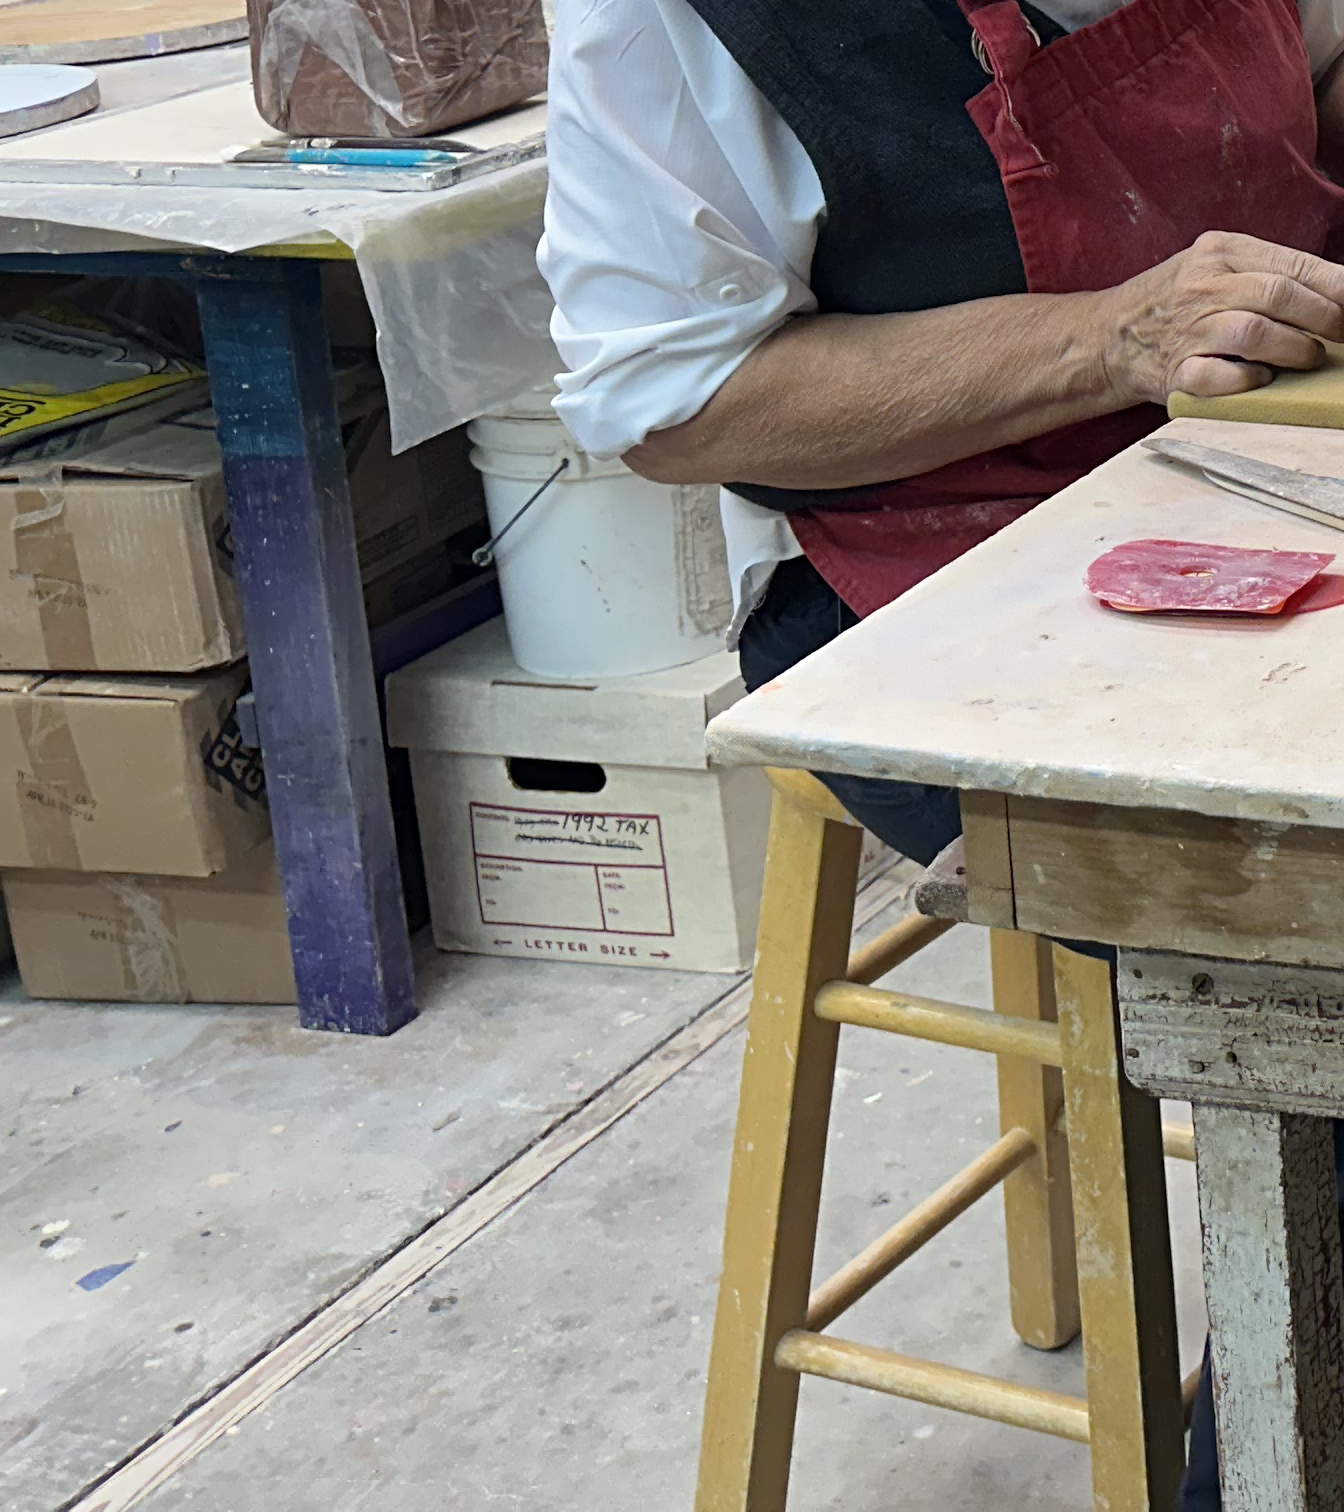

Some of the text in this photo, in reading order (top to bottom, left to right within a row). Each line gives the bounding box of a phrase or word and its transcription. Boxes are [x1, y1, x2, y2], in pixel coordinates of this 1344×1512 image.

[562, 814, 608, 832] 1992
[616, 819, 650, 835] TAX
[524, 939, 639, 957] LETTER SIZE
